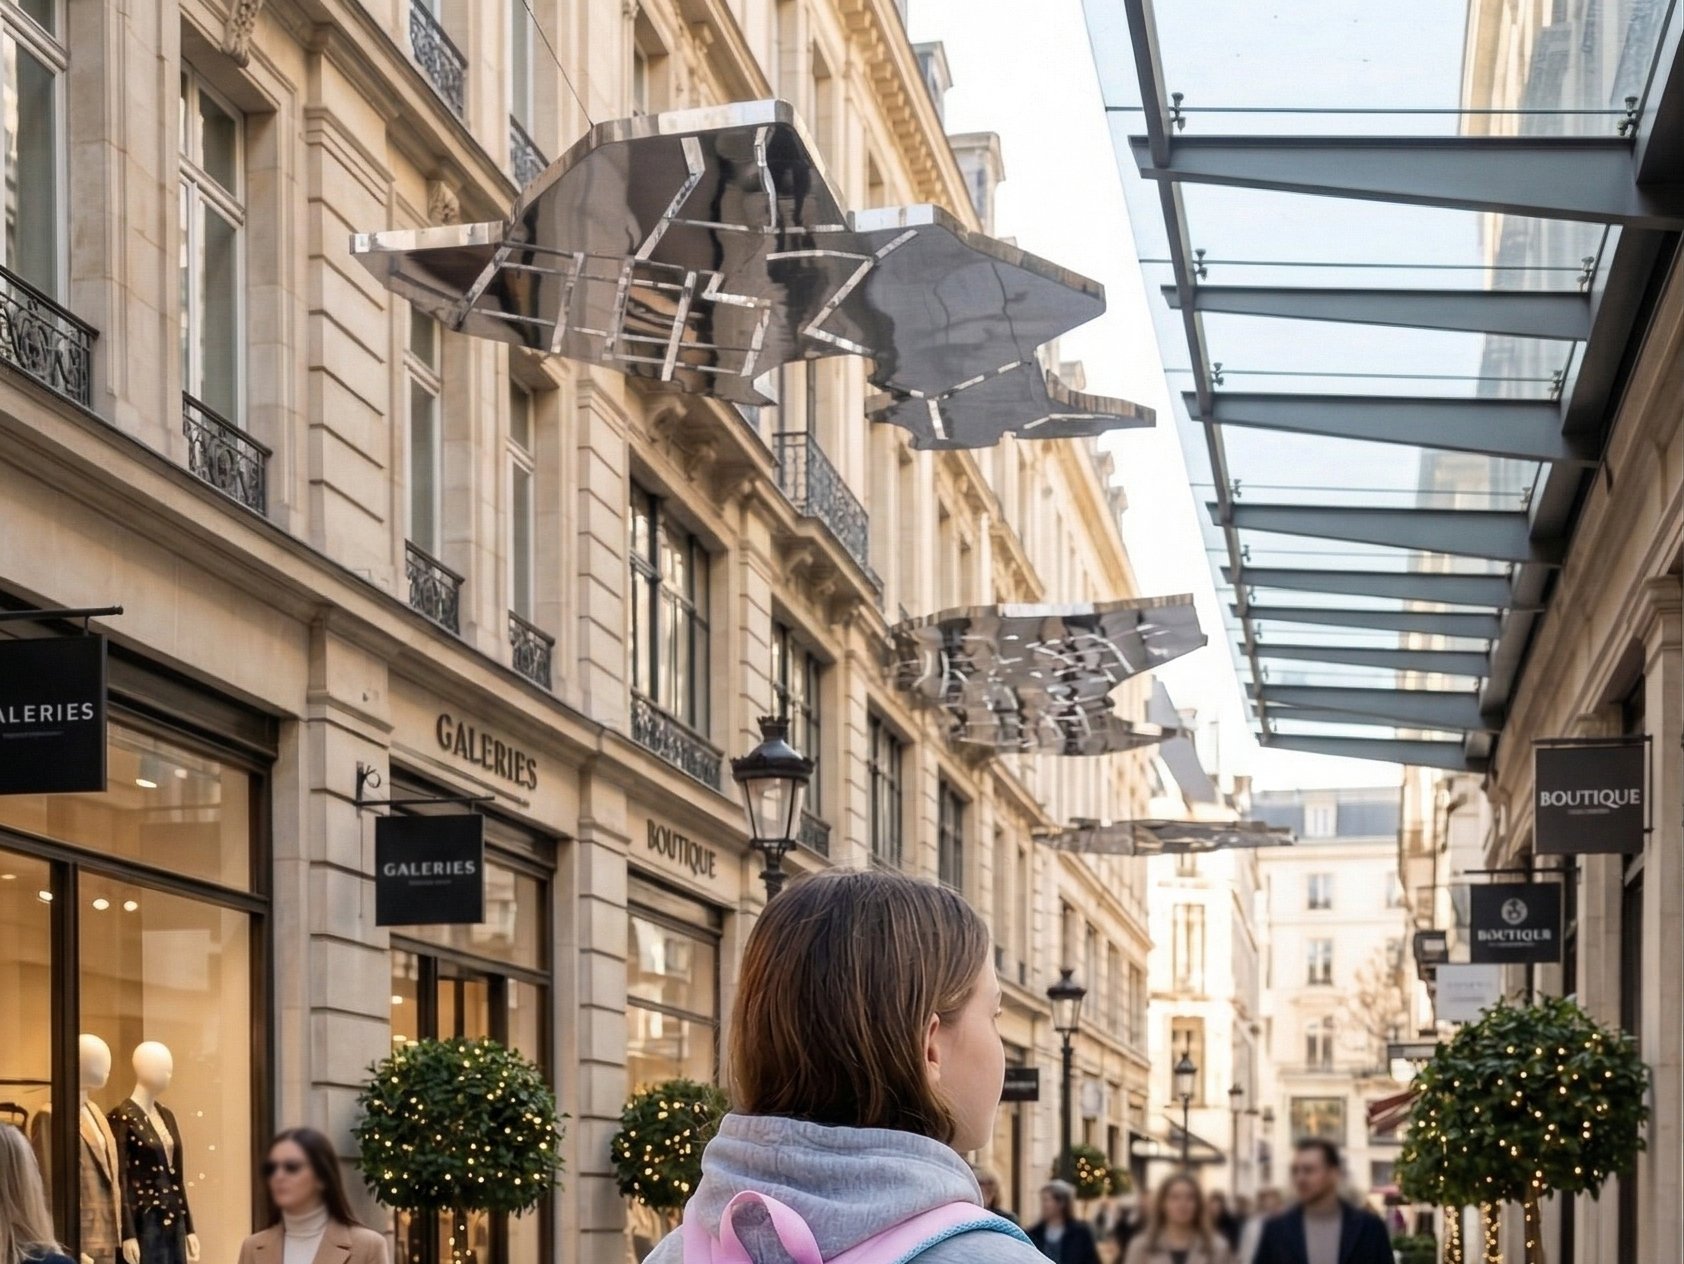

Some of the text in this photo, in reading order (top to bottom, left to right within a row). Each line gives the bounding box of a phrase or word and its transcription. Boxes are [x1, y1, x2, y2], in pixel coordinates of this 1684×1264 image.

[436, 713, 538, 791] GALERIES
[1540, 788, 1641, 809] BOUTIQUE
[383, 860, 476, 877] GALERIES
[646, 818, 717, 879] BOUTIQUE
